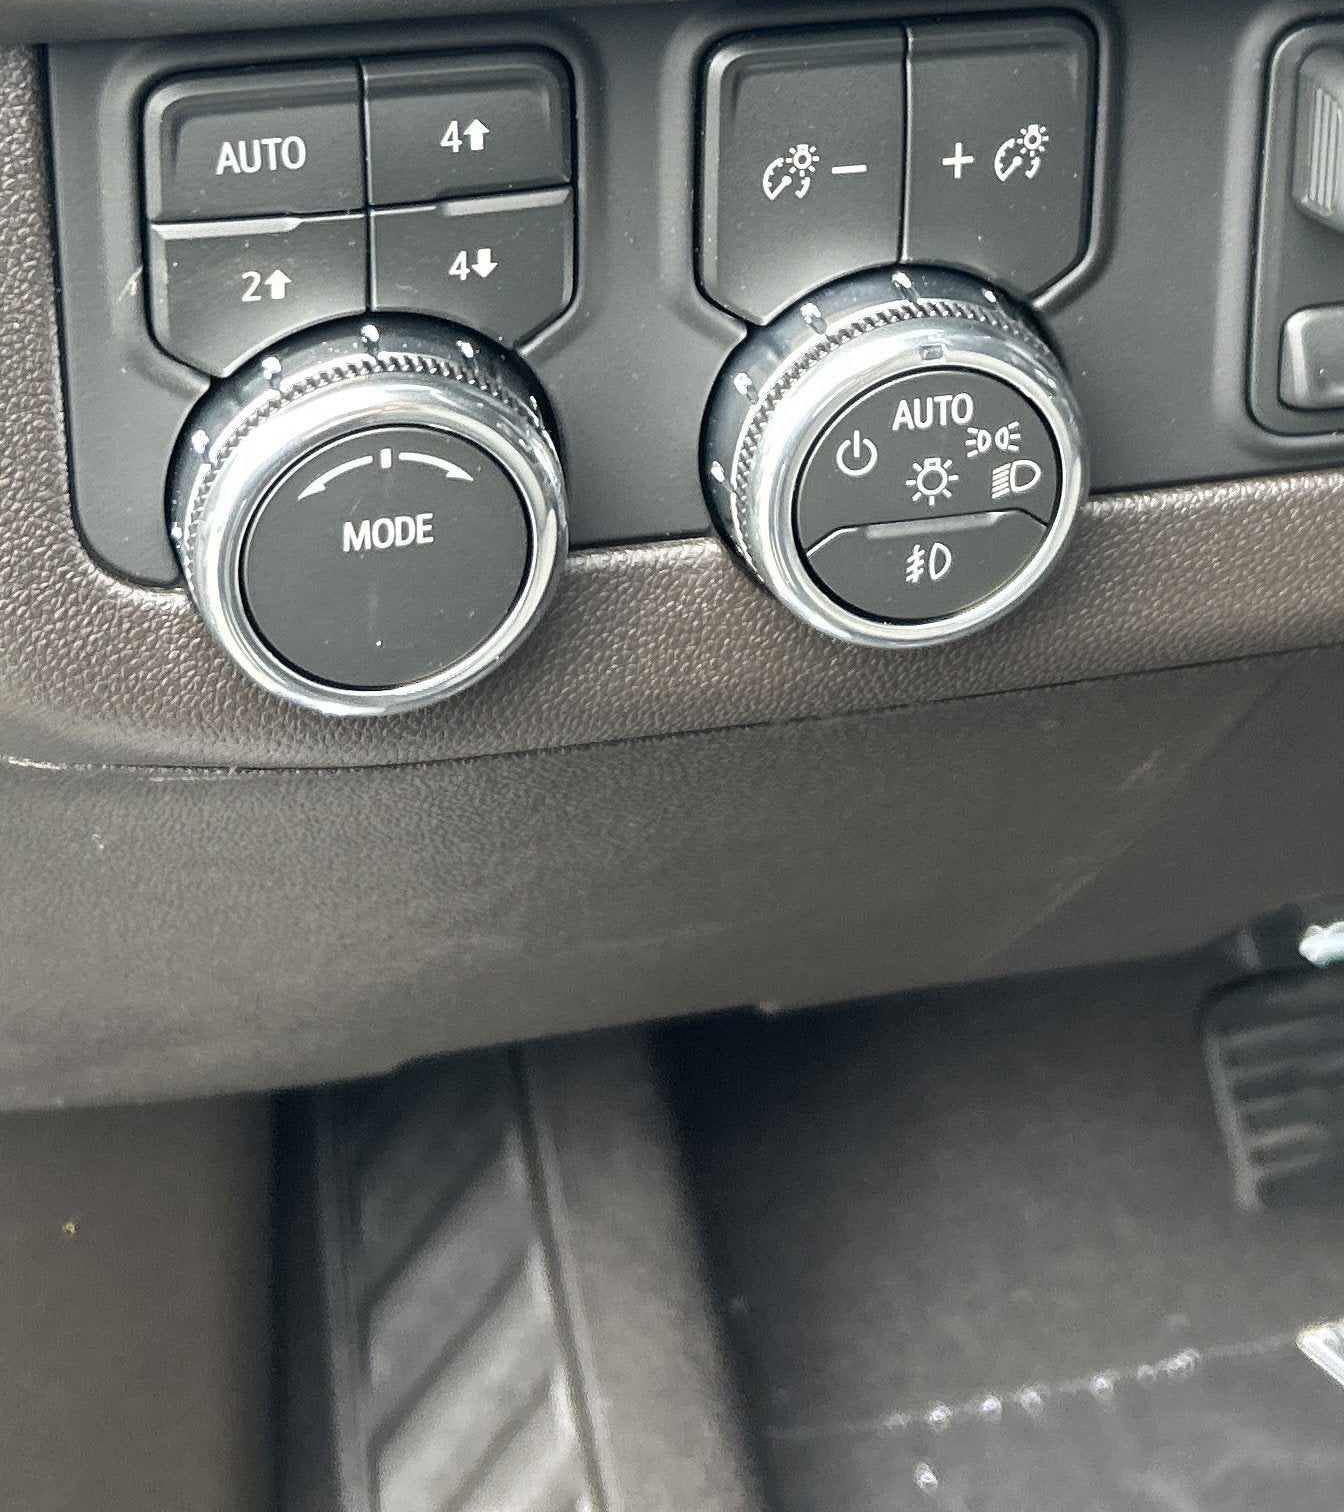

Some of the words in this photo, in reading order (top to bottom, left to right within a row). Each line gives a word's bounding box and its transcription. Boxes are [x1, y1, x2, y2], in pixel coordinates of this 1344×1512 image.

[440, 121, 462, 153] 4
[215, 135, 307, 176] AUTO
[448, 250, 469, 281] 4
[241, 271, 262, 303] 2
[891, 392, 974, 431] AUTO
[342, 512, 434, 553] MODE
